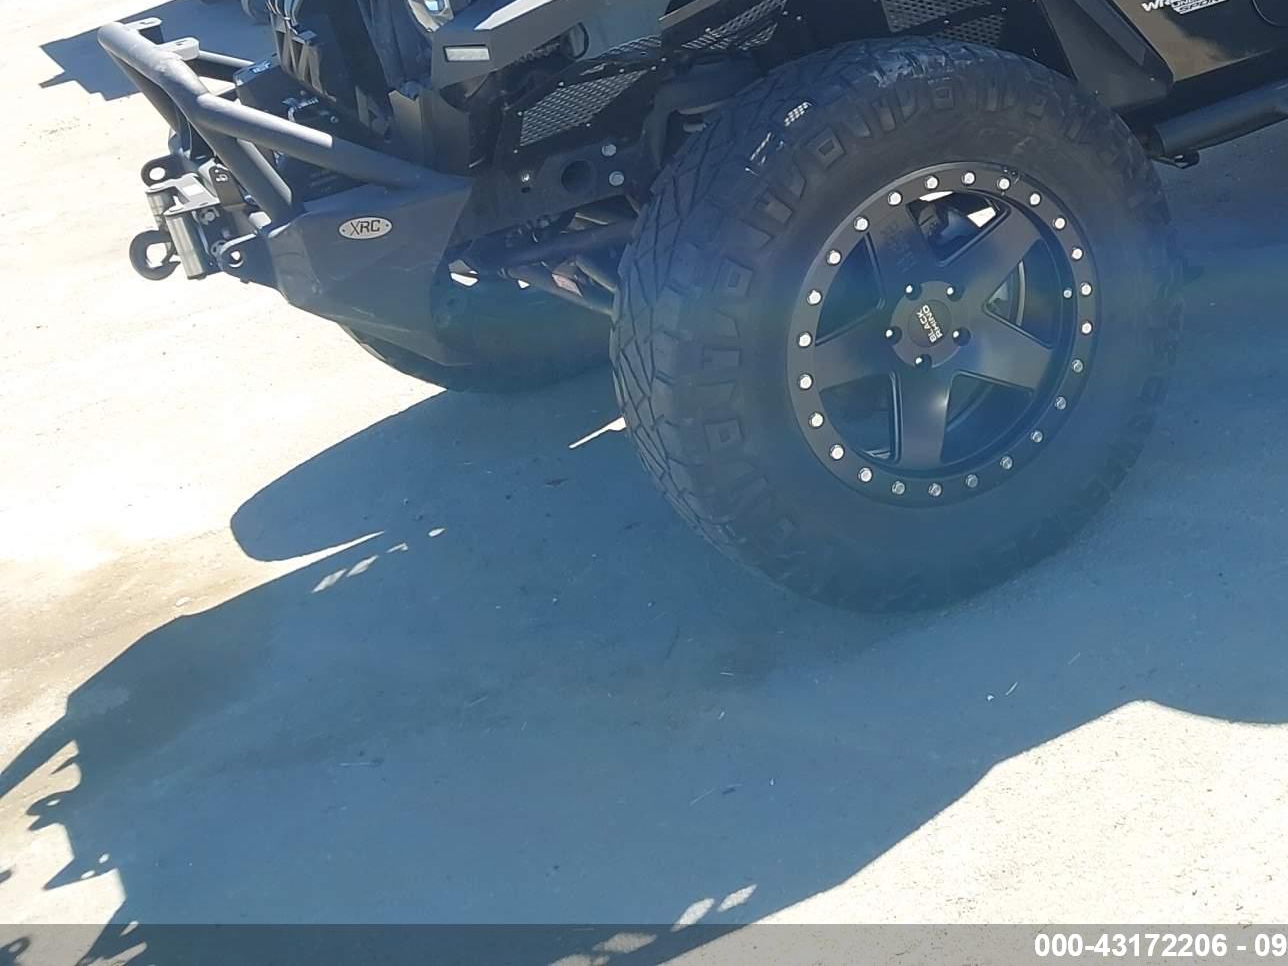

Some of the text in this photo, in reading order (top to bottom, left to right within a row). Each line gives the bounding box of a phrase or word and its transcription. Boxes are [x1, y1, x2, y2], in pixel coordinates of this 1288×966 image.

[350, 220, 380, 236] XRC
[916, 309, 937, 344] BLACK
[922, 304, 943, 339] RHINO
